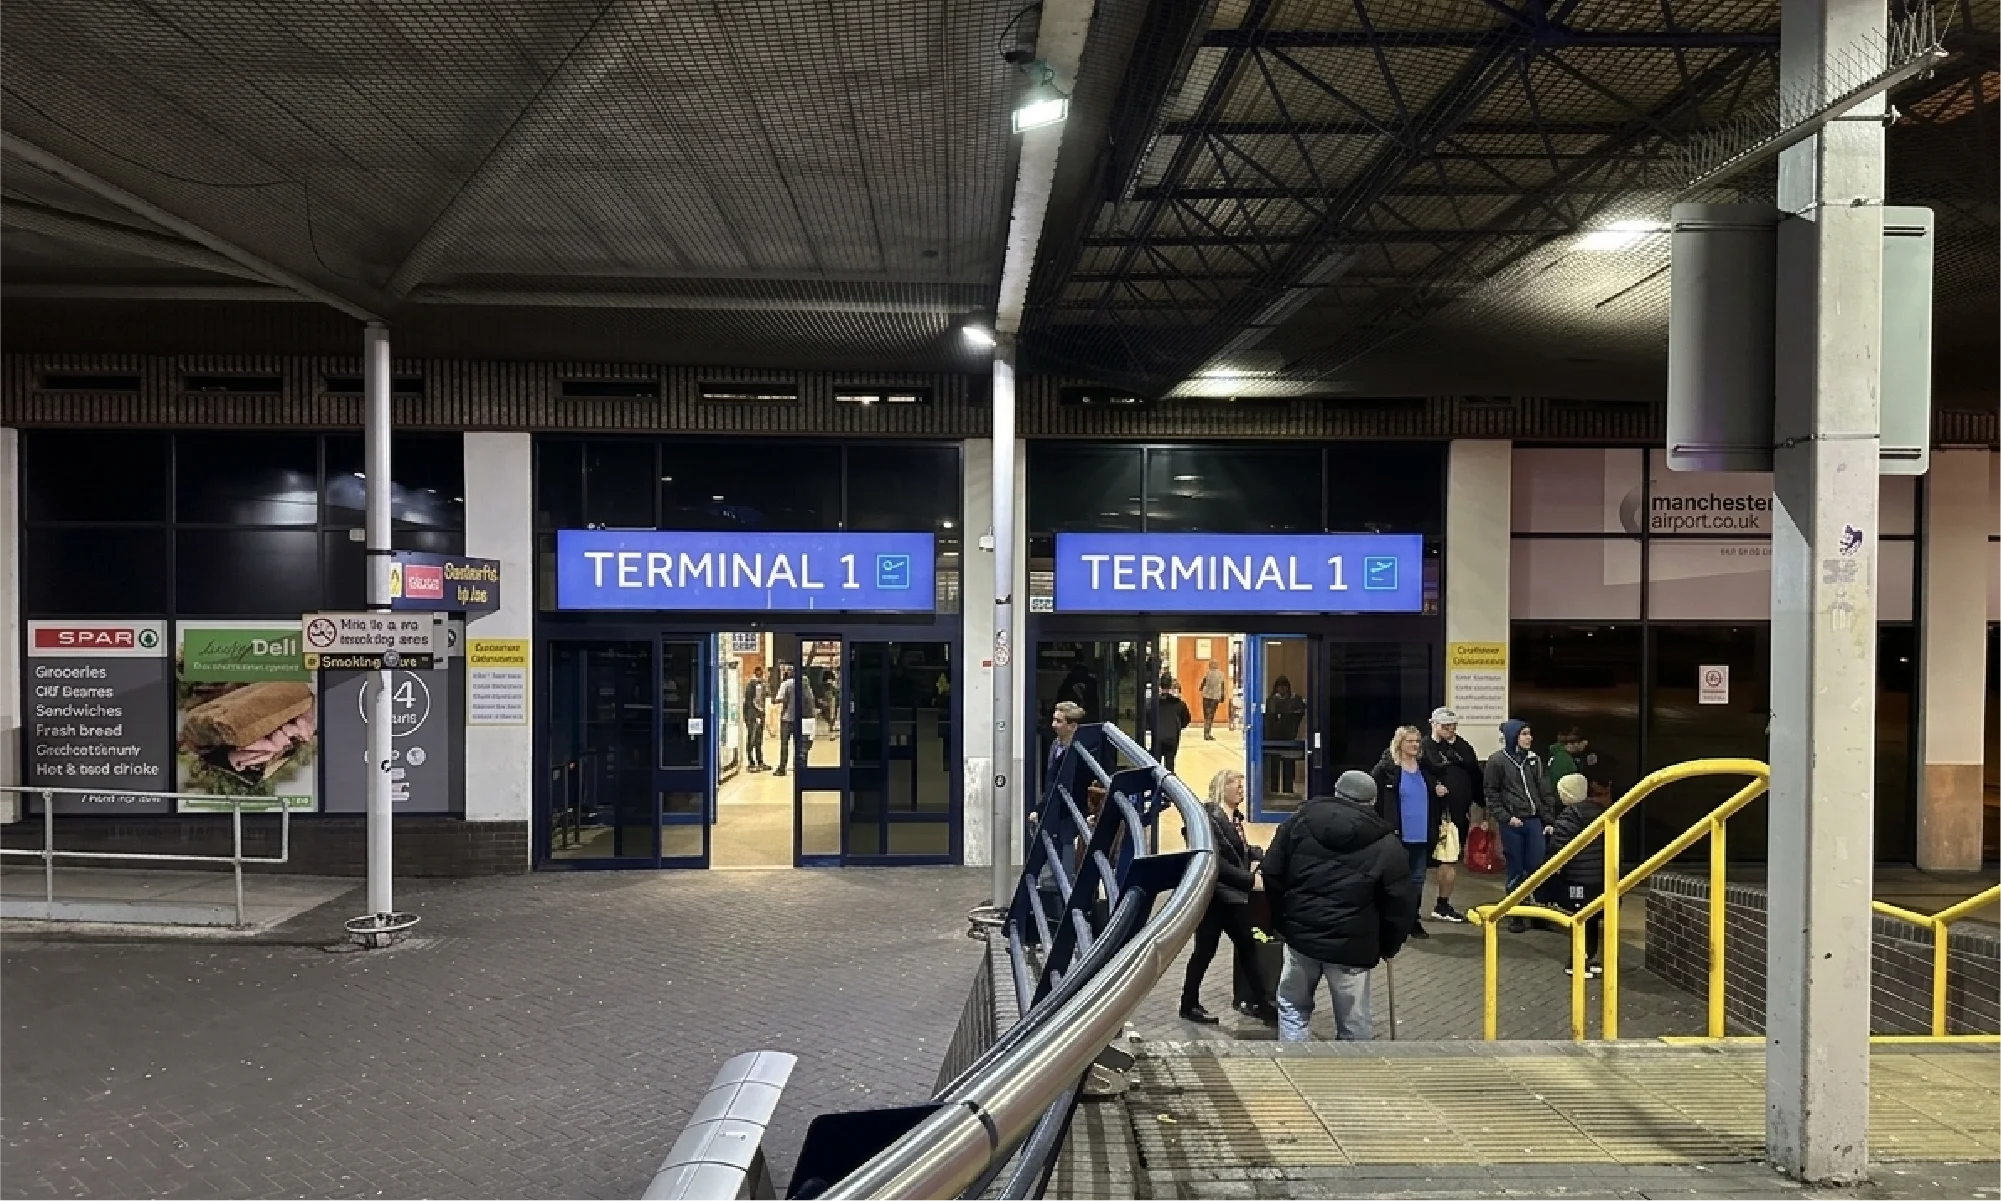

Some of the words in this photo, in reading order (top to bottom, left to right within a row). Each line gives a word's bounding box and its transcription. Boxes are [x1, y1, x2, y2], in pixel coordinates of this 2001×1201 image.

[1651, 492, 1773, 511] manchester
[1651, 512, 1760, 532] airport.co.uk
[584, 552, 825, 589] TERMINAL
[840, 554, 860, 589] 1
[1081, 554, 1313, 591] TERMINAL
[1327, 555, 1348, 591] 1
[57, 631, 132, 645] SPAR
[322, 656, 382, 670] Smoking
[393, 680, 417, 709] 4
